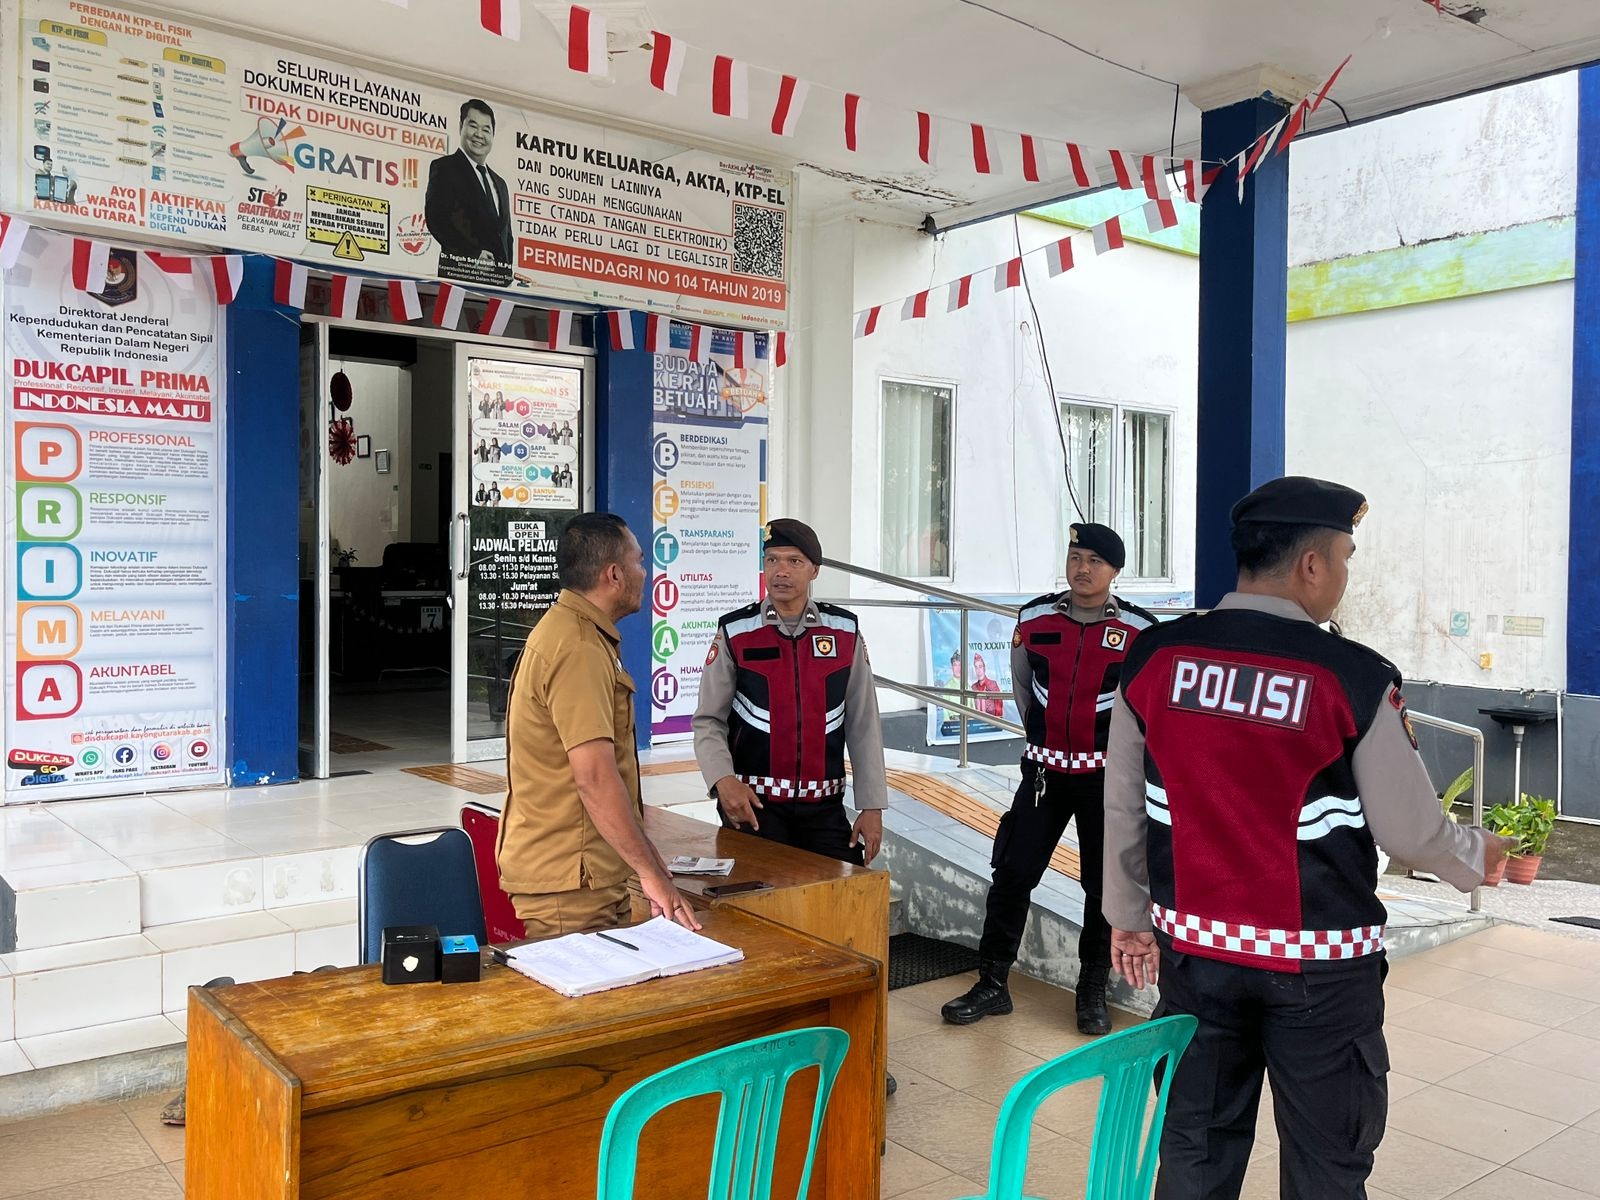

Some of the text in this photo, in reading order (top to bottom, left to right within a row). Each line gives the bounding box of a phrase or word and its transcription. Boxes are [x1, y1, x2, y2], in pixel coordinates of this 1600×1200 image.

[70, 2, 192, 38] PERBEDAAN KTP-EL FISIK
[80, 16, 182, 46] DENGAN KTP DIGITAL
[277, 59, 421, 107] SELURUH LAYANAN
[244, 69, 325, 103] DOKUMEN
[328, 89, 448, 130] KEPENDUDUKAN
[245, 94, 301, 120] TIDAK
[306, 108, 397, 141] DIPUNGUT
[401, 131, 446, 152] BIAYA
[516, 132, 578, 161] KARTU
[583, 147, 682, 188] KELUARGA,
[685, 174, 731, 197] AKTA,
[734, 181, 785, 206] KTP-EL
[517, 157, 662, 199] DAN DOKUMEN LAINNYA
[111, 186, 136, 198] AYO
[322, 191, 373, 209] PERINGATAN
[517, 179, 683, 223] YANG SUDAH MENGGUNAKAN
[34, 197, 137, 224] KAYONG UTARA
[86, 194, 136, 211] WARGA
[150, 191, 225, 214] AKTIFKAN
[238, 202, 291, 221] GRATIFIKASI
[150, 213, 227, 232] KEPENDUDUKAN
[311, 210, 385, 230] MEMBERIKAN SESUATU
[336, 208, 361, 218] JANGAN
[150, 221, 187, 234] DIGITAL
[237, 215, 300, 231] PELAYANAN KAMI
[241, 223, 296, 239] BEBAS PUNGLI
[310, 218, 367, 234] KEPADA PETUGAS
[517, 199, 728, 252] TTE (TANDA TANGAN ELEKTRONIK)
[517, 220, 728, 270] TIDAK PERLU LAGI DI LEGALISIR
[450, 254, 466, 262] Teguh
[523, 245, 644, 282] PERMENDAGRI
[647, 267, 670, 285] NO
[675, 272, 698, 290] 104
[701, 278, 749, 299] TAHUN
[751, 285, 782, 304] 2019
[59, 305, 169, 327] Direktorat Jenderal
[9, 312, 213, 344] Kependudukan dan Pencatatan Sipil
[37, 328, 190, 354] Kementerian Dalam Negeri
[60, 342, 168, 364] Republik Indonesia
[653, 354, 718, 377] BUDAYA
[14, 359, 210, 394] DUKCAPIL PRIMA
[653, 371, 718, 394] KERJA
[19, 391, 206, 420] INDONESIA MAJU
[653, 389, 718, 410] BETUAH
[89, 430, 195, 448] PROFESSIONAL
[680, 434, 728, 445] BERDEDIKASI
[39, 441, 62, 465] P
[660, 443, 675, 467] B
[680, 481, 715, 489] EFISIENSI
[89, 492, 167, 506] RESPONSIF
[660, 490, 674, 513] E
[37, 500, 61, 524] R
[514, 531, 540, 539] OPEN
[680, 529, 735, 538] TRANSPARANSI
[473, 538, 515, 552] JADWAL
[660, 537, 674, 561] T
[90, 551, 158, 563] INOVATIF
[494, 554, 557, 563] Senin s/d Kamis
[45, 559, 54, 583] I
[478, 563, 553, 573] 08.00 11.30 Pelayanan
[480, 572, 551, 581] 13.30 15.30 Pelayanan
[680, 573, 713, 582] UTILITAS
[510, 581, 538, 591] Jum'at
[659, 583, 674, 601] U
[479, 602, 550, 611] 13.30 15.30 Pelayanan
[502, 592, 519, 600] 10.30
[520, 592, 553, 602] Pelayanan
[90, 610, 165, 622] MELAYANI
[427, 614, 436, 628] 7
[37, 620, 66, 644] M
[659, 630, 675, 653] A
[984, 641, 1005, 651] XXXIV
[89, 664, 176, 678] AKUNTABEL
[37, 677, 62, 702] A
[658, 677, 675, 700] H
[1171, 660, 1308, 724] POLISI
[14, 751, 73, 764] DUKCAPIL
[40, 765, 58, 774] GO
[24, 774, 68, 786] DIGITAL
